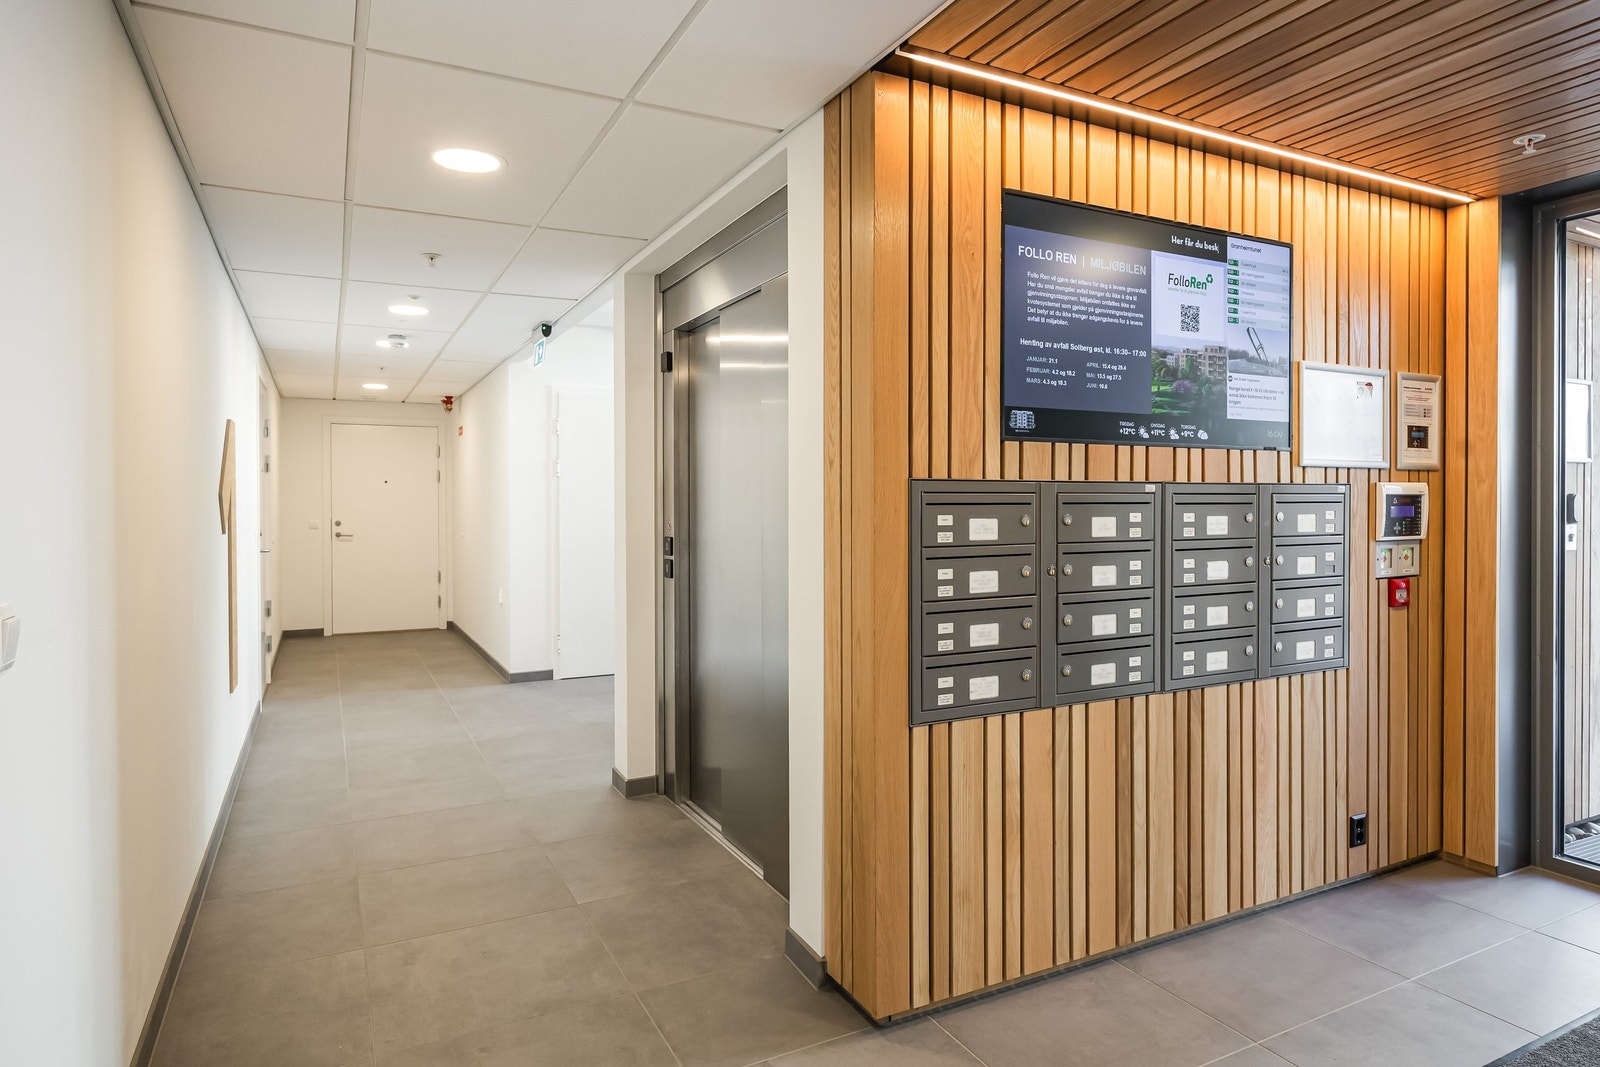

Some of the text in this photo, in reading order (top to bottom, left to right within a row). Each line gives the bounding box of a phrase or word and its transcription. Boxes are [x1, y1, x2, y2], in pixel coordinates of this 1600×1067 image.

[1171, 235, 1183, 245] Her
[1185, 237, 1194, 247] får
[1195, 240, 1203, 248] du
[1018, 245, 1146, 275] FOLLO REN MILJØBILEN
[1168, 273, 1207, 290] FolloRen
[1037, 308, 1048, 316] betyr
[1020, 338, 1044, 348] Henting
[1070, 344, 1092, 353] Solberg
